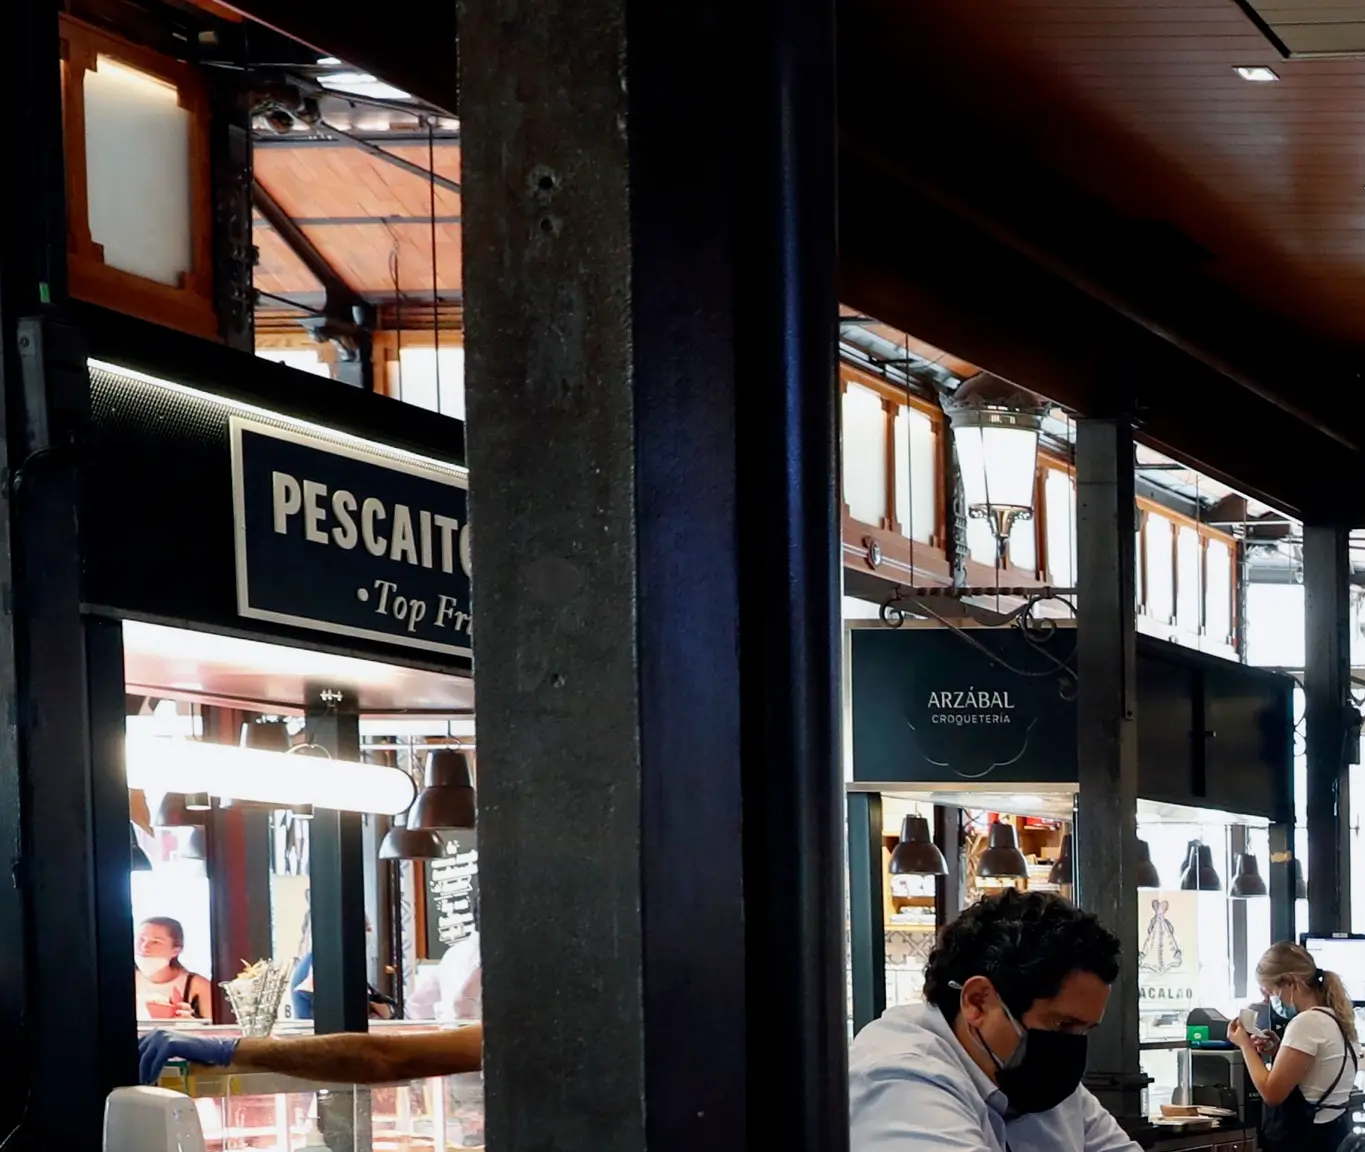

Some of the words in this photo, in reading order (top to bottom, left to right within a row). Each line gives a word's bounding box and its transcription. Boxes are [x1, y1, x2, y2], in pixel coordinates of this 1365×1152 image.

[927, 685, 1015, 709] ARZÁBAL
[931, 712, 1011, 726] CROQUETERÍA
[1139, 987, 1193, 1000] ACALAO
